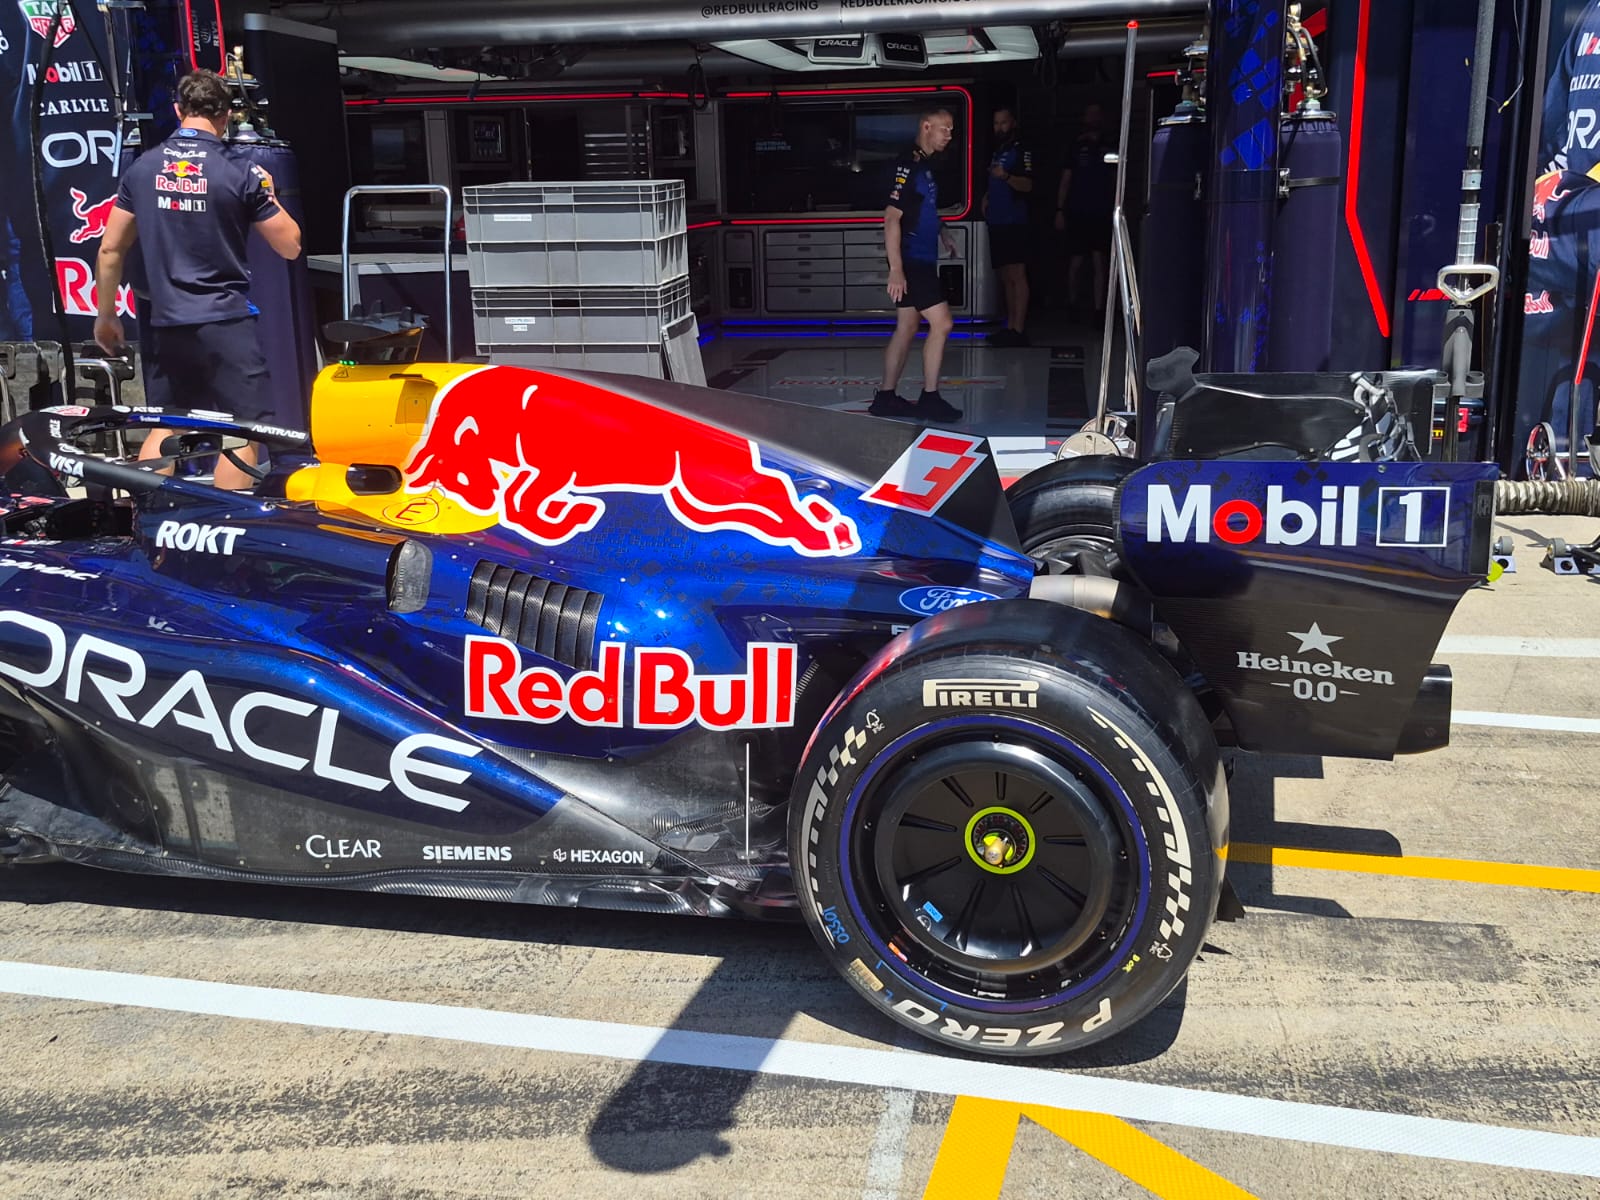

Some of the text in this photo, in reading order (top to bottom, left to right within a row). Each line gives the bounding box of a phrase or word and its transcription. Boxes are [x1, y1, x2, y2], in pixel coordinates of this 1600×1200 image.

[24, 0, 69, 16] TA
[701, 1, 818, 18] @REDBULLRACING
[818, 38, 859, 47] ORACLE
[163, 147, 207, 158] ORACLE
[180, 178, 207, 194] Bull
[158, 196, 192, 212] Mobil
[252, 424, 307, 440] AVATRADE
[49, 452, 85, 478] VISA
[858, 428, 989, 518] 3
[1147, 484, 1360, 546] Mobil
[155, 520, 246, 556] ROKT
[1236, 651, 1395, 686] Heineken
[464, 634, 798, 731] Red Bull
[922, 679, 1040, 709] PIRELLI
[1293, 678, 1337, 702] 0.0
[0, 609, 483, 813] ORACLE
[305, 834, 382, 859] CLEAR
[422, 845, 513, 862] SIEMENS
[570, 849, 645, 865] HEXAGON
[891, 997, 1113, 1048] P ZERO
